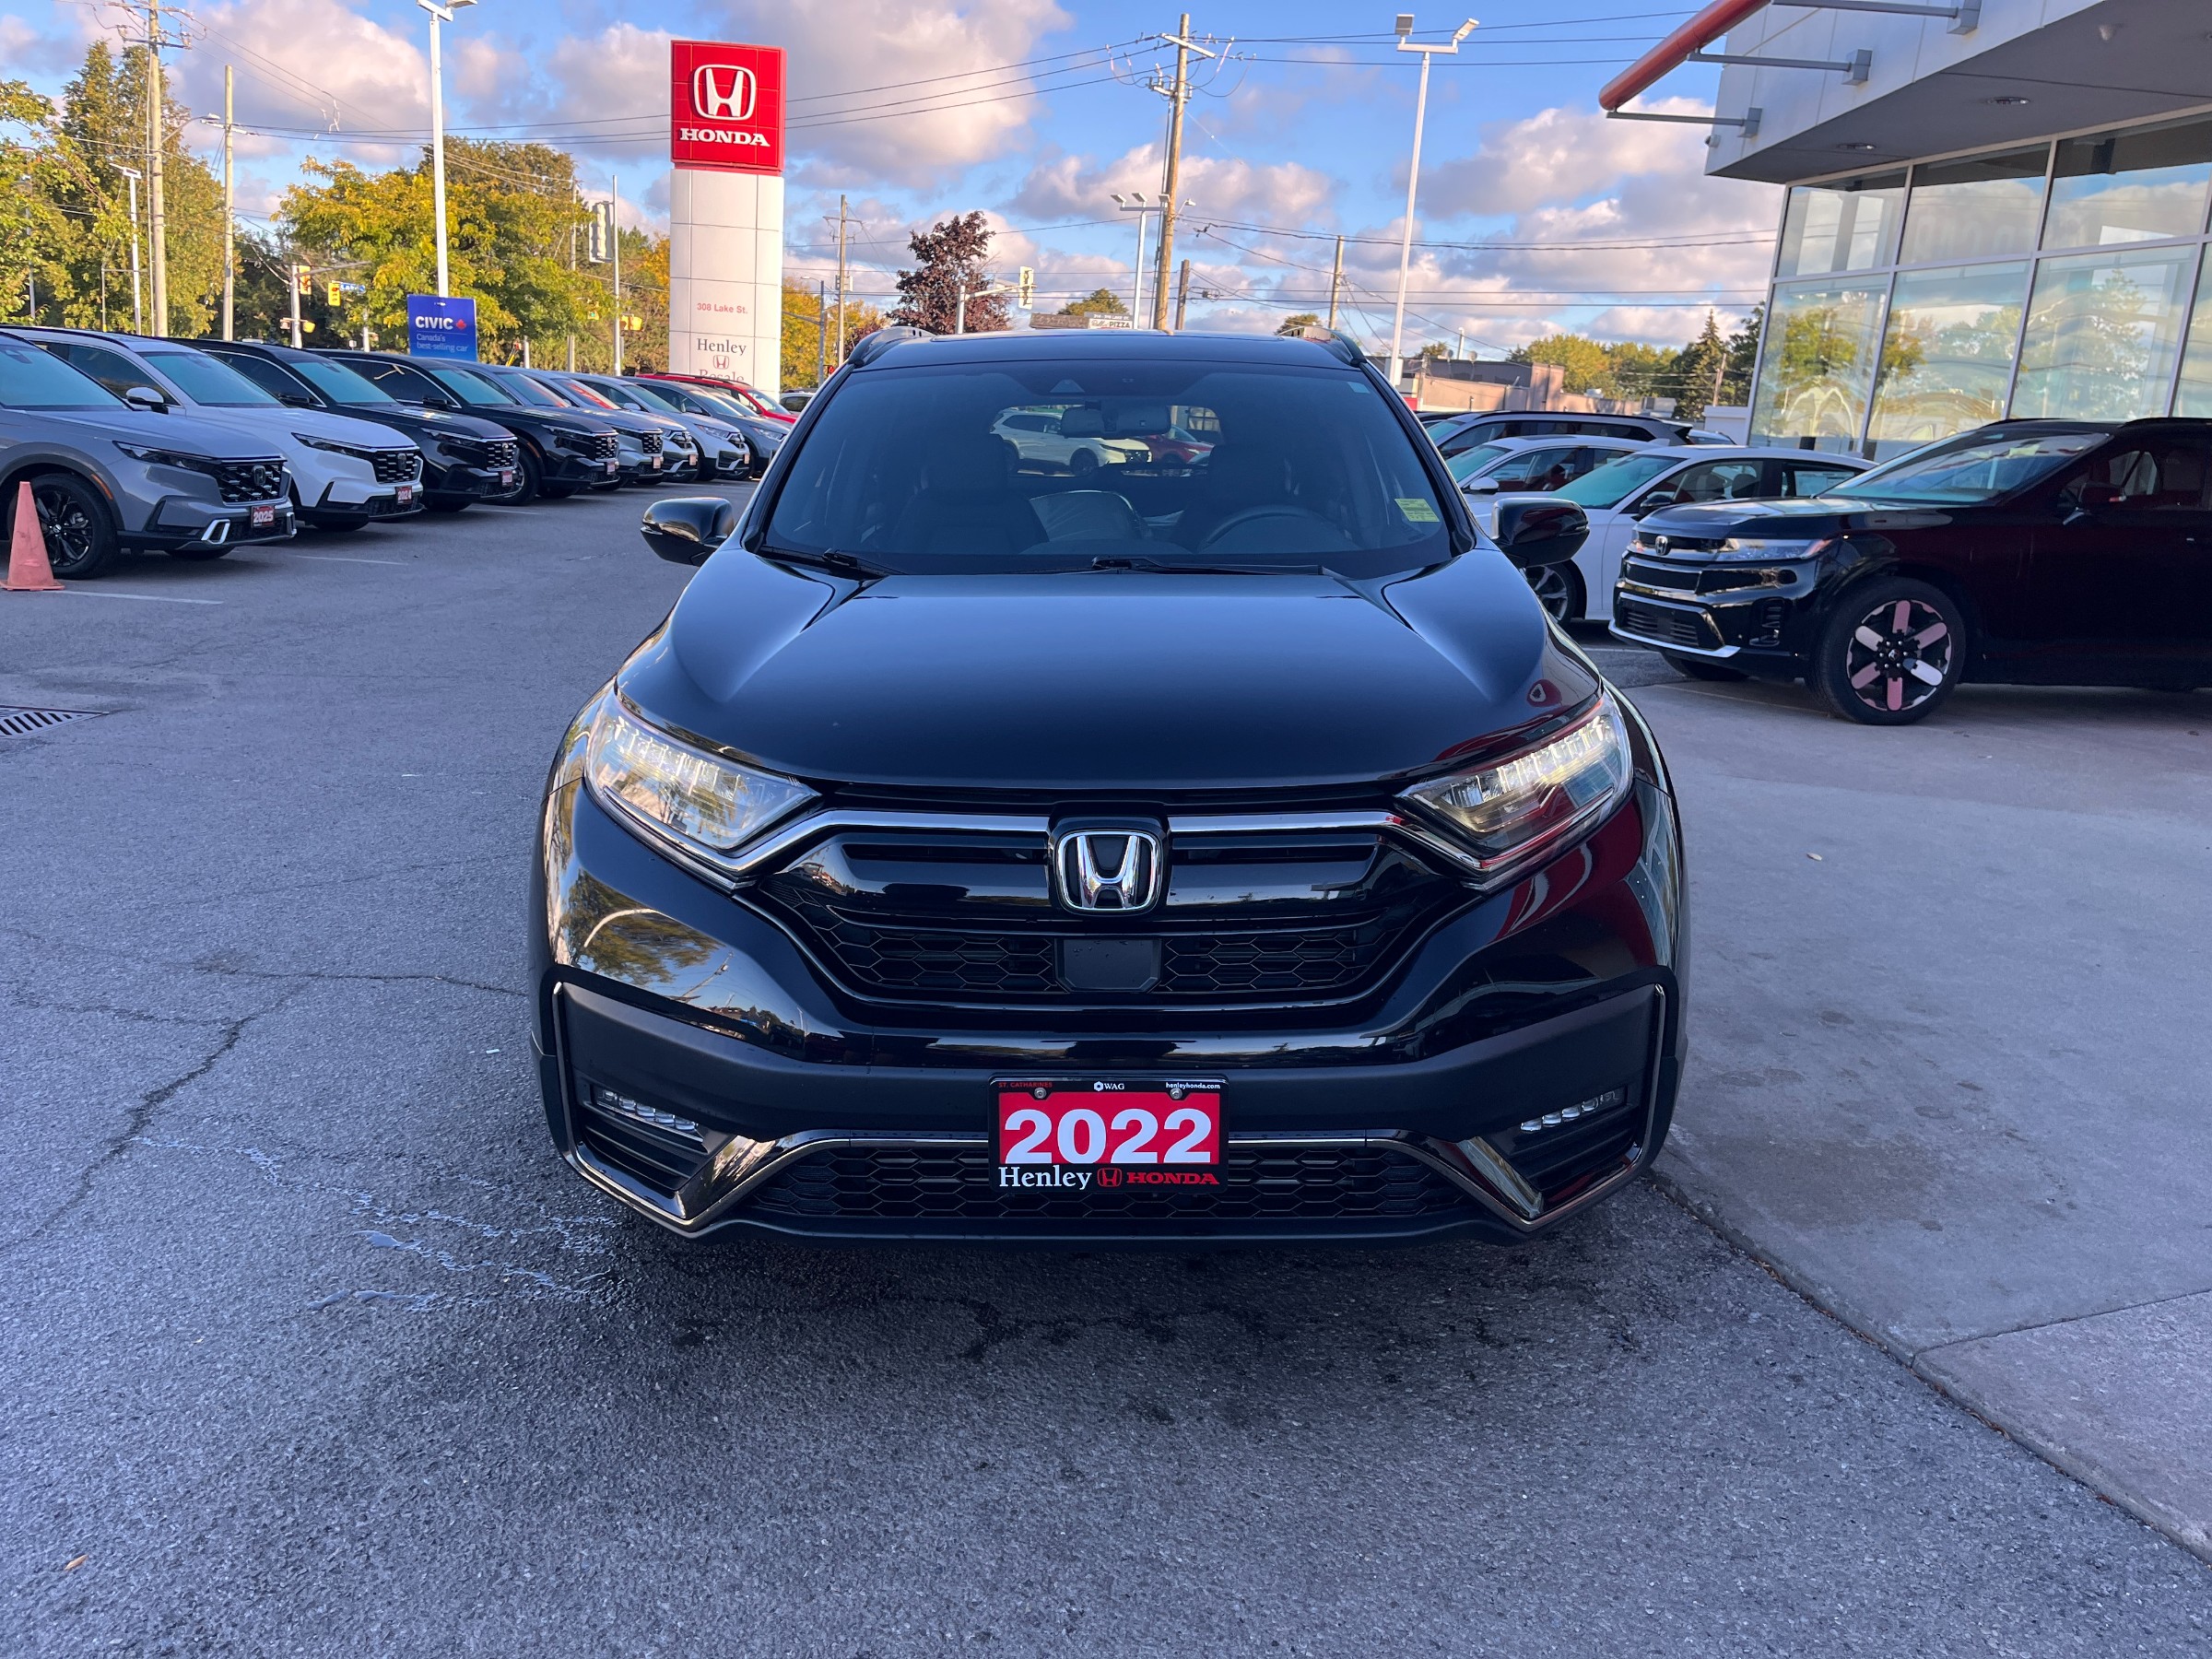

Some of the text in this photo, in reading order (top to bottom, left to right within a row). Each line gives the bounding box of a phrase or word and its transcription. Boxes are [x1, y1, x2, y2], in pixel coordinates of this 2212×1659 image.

[680, 127, 771, 147] HONDA
[697, 302, 712, 312] 308
[714, 303, 735, 313] Lake
[415, 315, 453, 330] CIVIC
[416, 333, 446, 342] Canada's
[417, 342, 455, 353] best-selling
[697, 337, 747, 357] Henley
[253, 510, 274, 524] 2025
[1104, 1082, 1125, 1090] WAG
[1165, 1081, 1221, 1090] henleyhonda.com
[1004, 1108, 1212, 1165] 2022
[998, 1165, 1220, 1191] Henley HONDA
